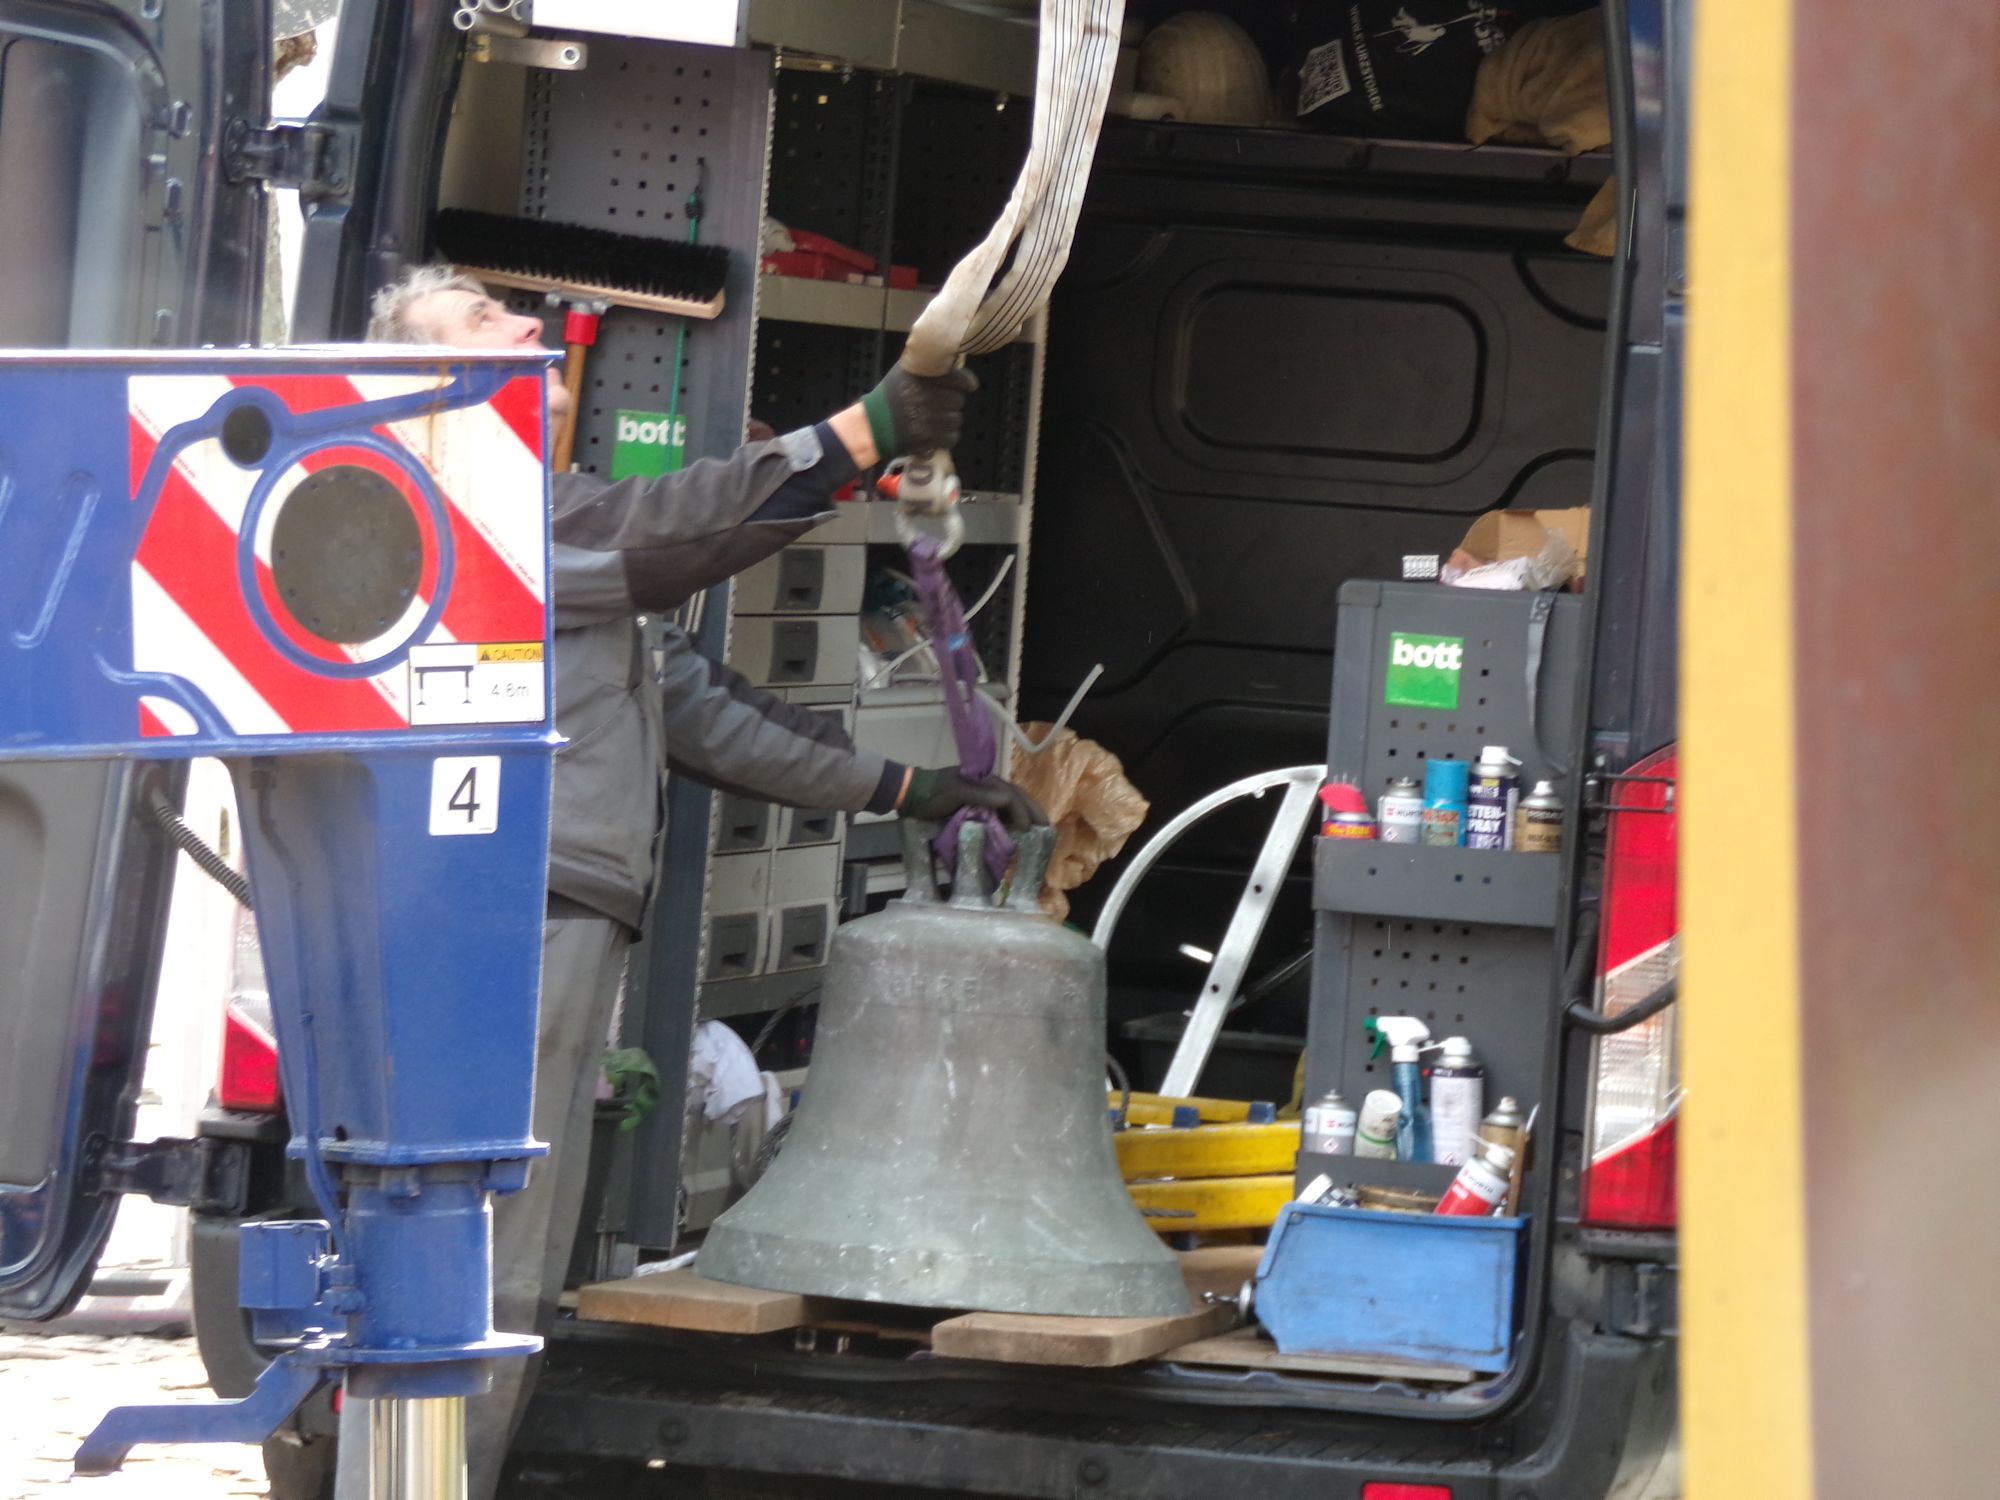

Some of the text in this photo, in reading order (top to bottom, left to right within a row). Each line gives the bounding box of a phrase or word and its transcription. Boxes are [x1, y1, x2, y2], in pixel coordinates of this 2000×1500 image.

[617, 415, 686, 447] bott
[494, 647, 543, 662] CAUTION
[1392, 638, 1464, 671] bott
[448, 766, 480, 823] 4
